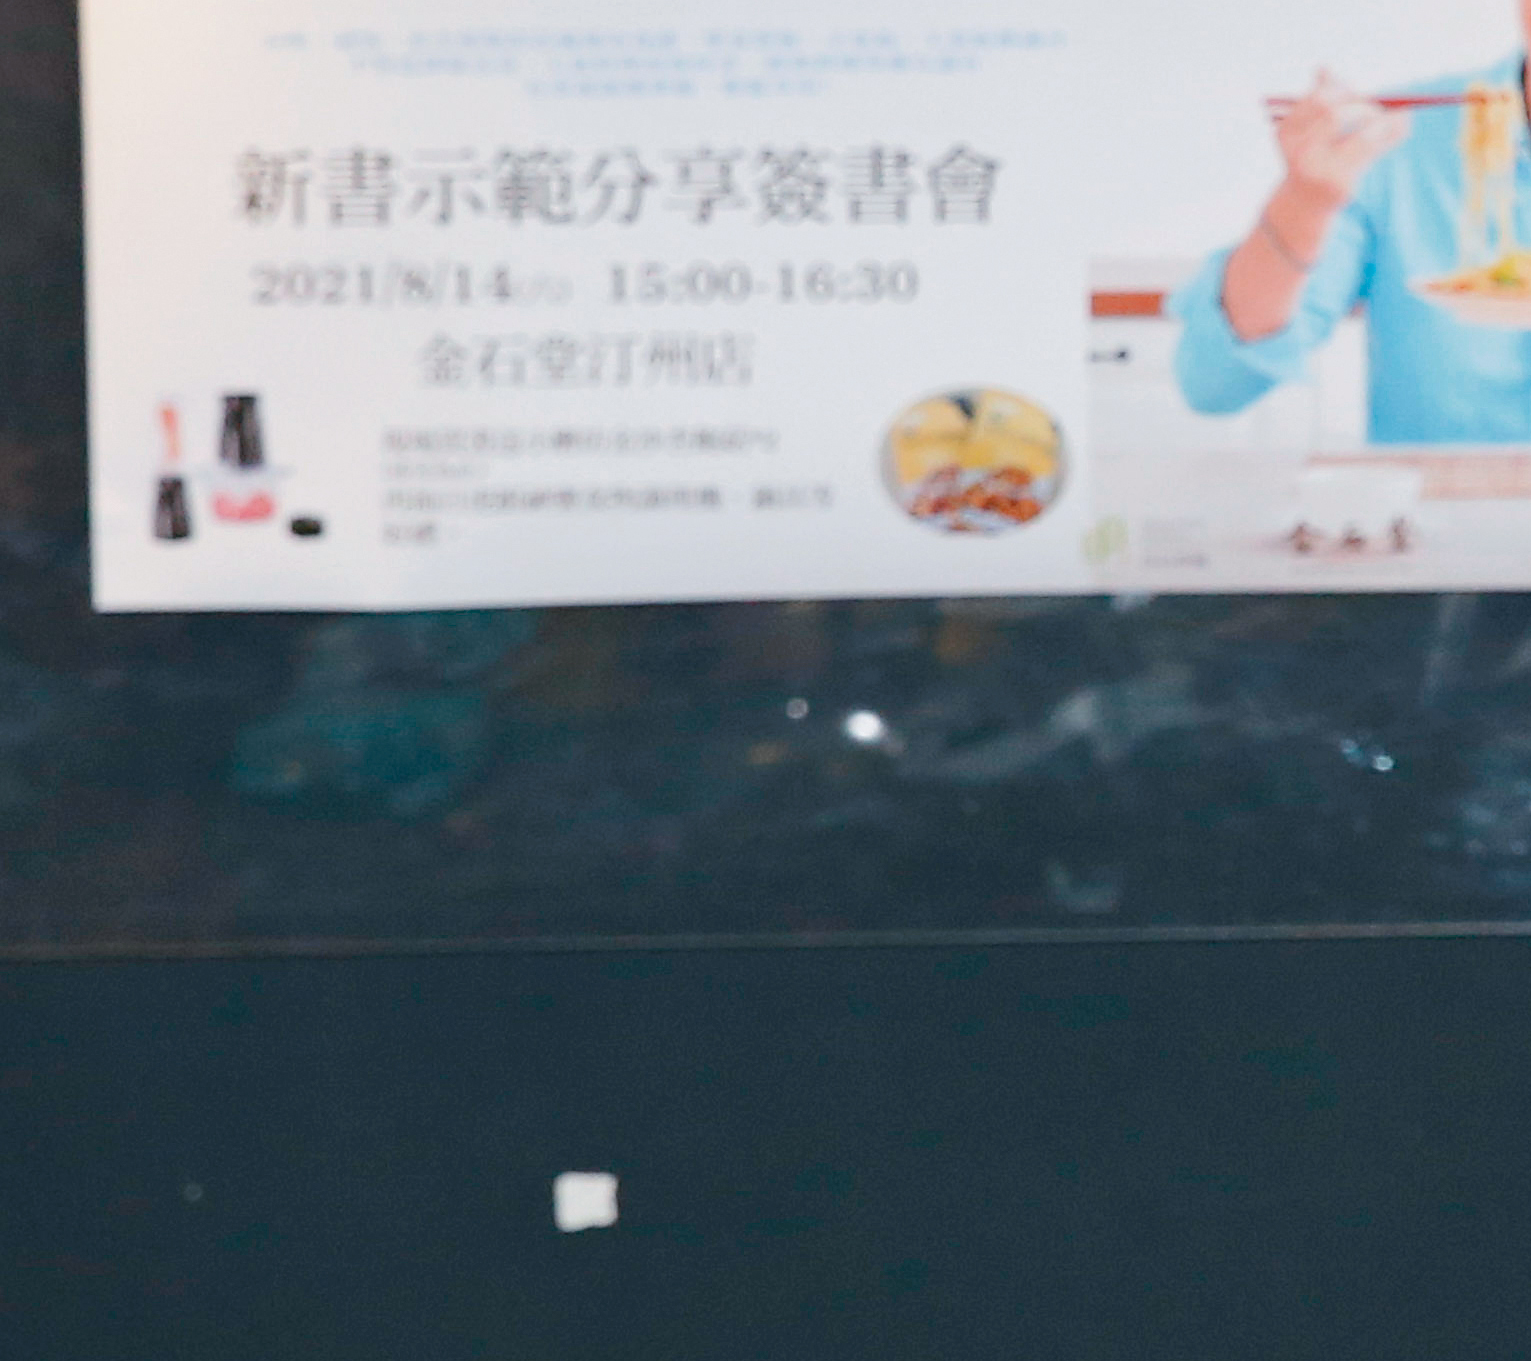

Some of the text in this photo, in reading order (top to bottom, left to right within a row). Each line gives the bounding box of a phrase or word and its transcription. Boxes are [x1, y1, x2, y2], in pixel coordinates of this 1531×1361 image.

[238, 142, 1003, 228] 新書示範分享簽書會
